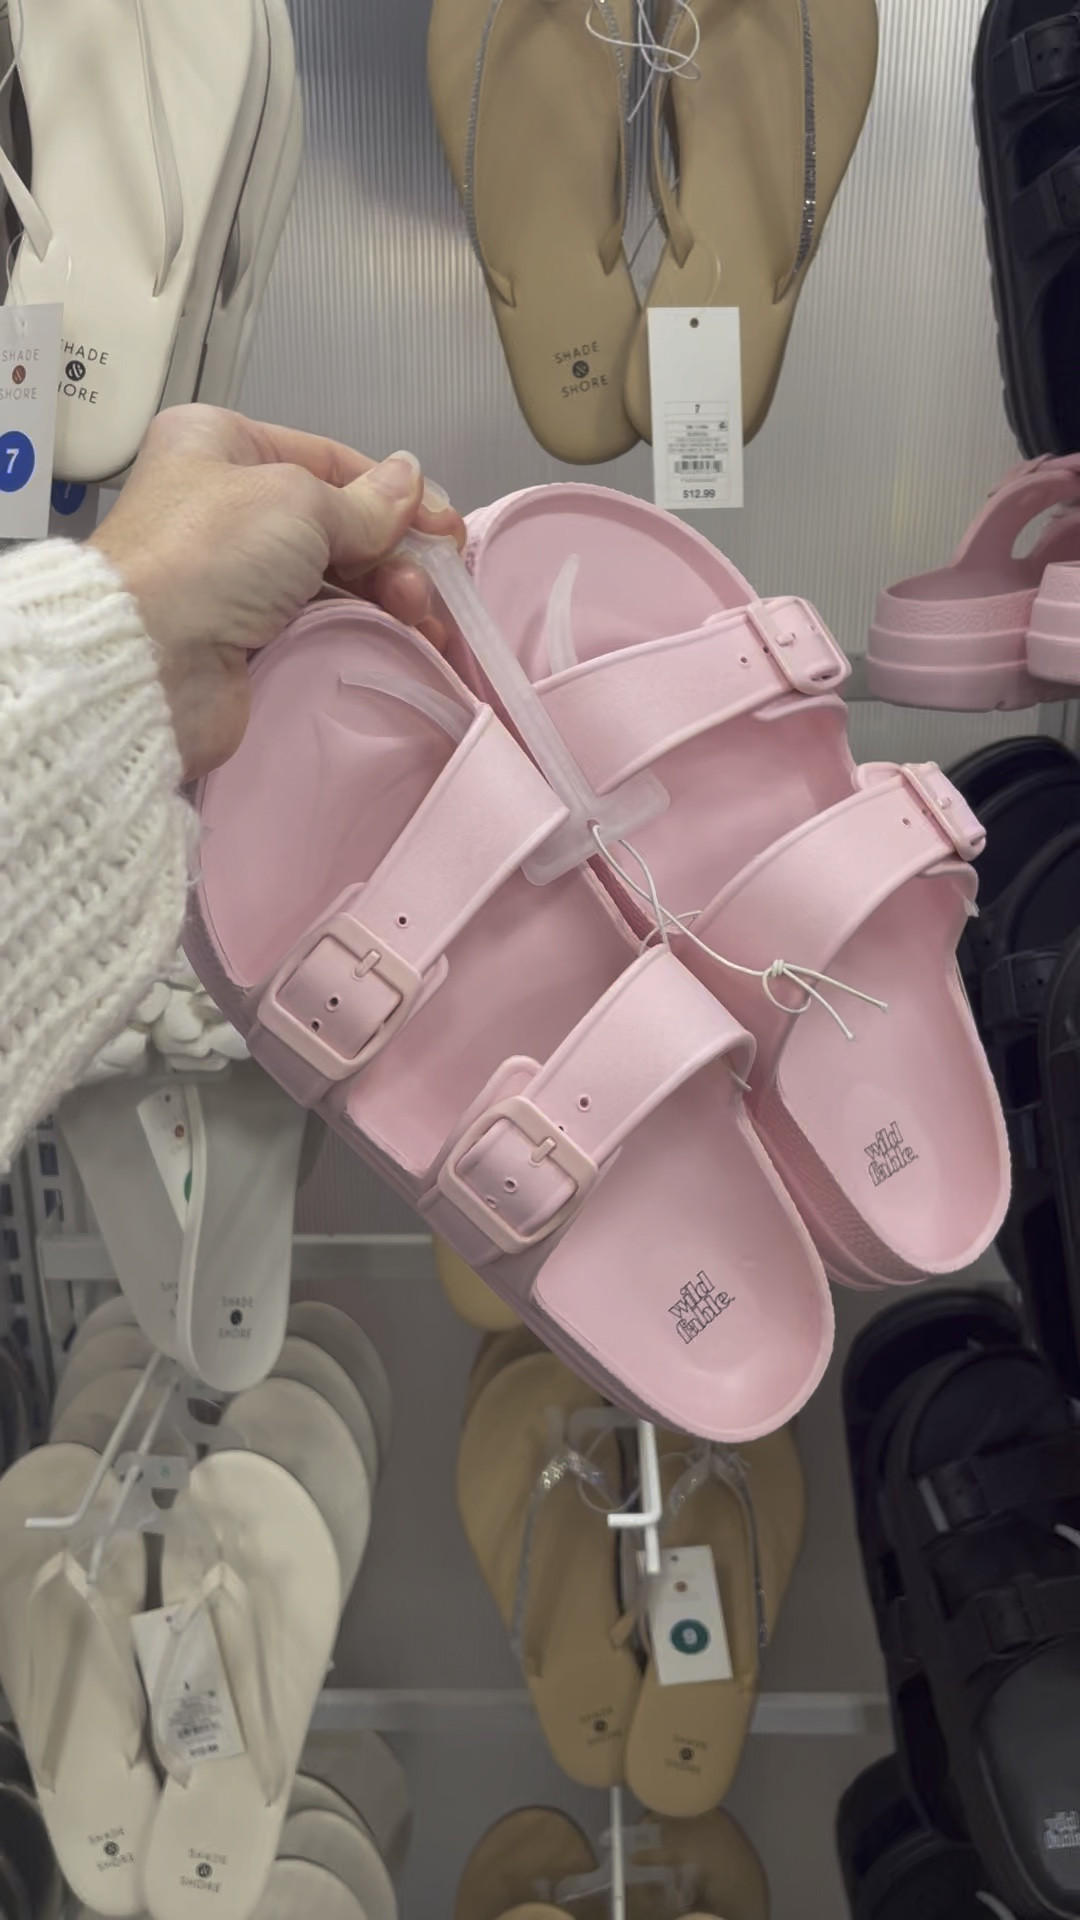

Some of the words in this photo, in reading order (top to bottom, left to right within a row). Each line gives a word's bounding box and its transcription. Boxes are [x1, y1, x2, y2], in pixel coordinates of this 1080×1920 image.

[2, 348, 40, 362] SHADE
[61, 339, 109, 366] HADE
[554, 341, 600, 365] SHADE
[66, 360, 85, 380] &
[0, 387, 38, 400] SHORE
[561, 375, 609, 398] SHORE
[695, 403, 701, 414] 7
[6, 448, 20, 475] 7
[682, 488, 716, 499] $12.99
[864, 1120, 904, 1160] wild
[667, 1269, 716, 1319] wild
